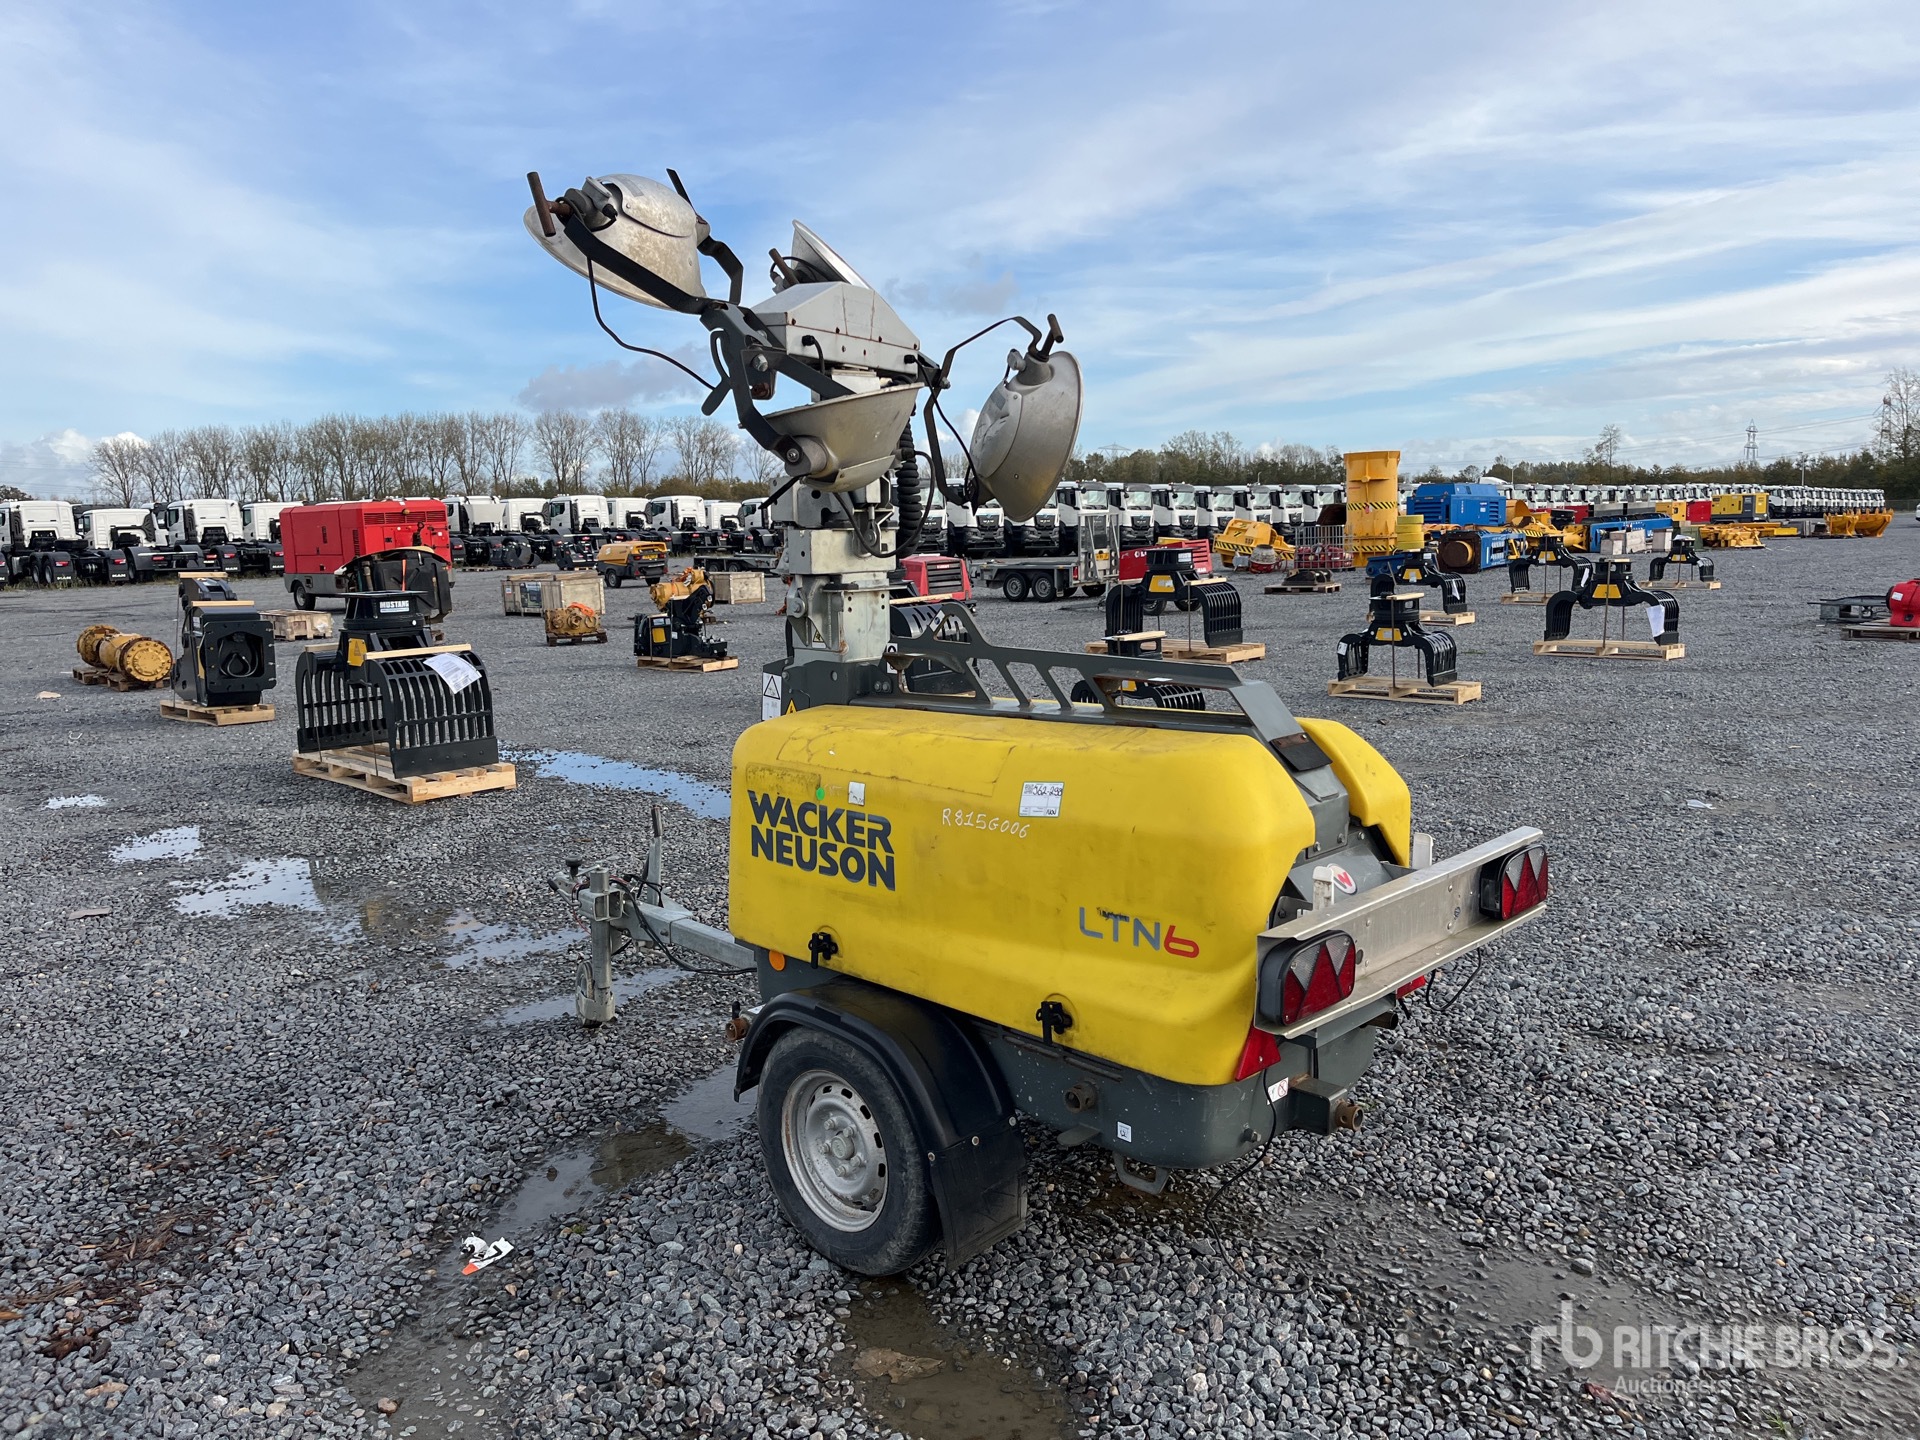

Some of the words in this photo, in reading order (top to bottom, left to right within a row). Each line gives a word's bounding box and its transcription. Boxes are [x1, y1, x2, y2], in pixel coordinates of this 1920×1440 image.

[747, 790, 894, 854] WACKER
[751, 824, 896, 892] NEUSON
[1079, 906, 1200, 958] LTN6
